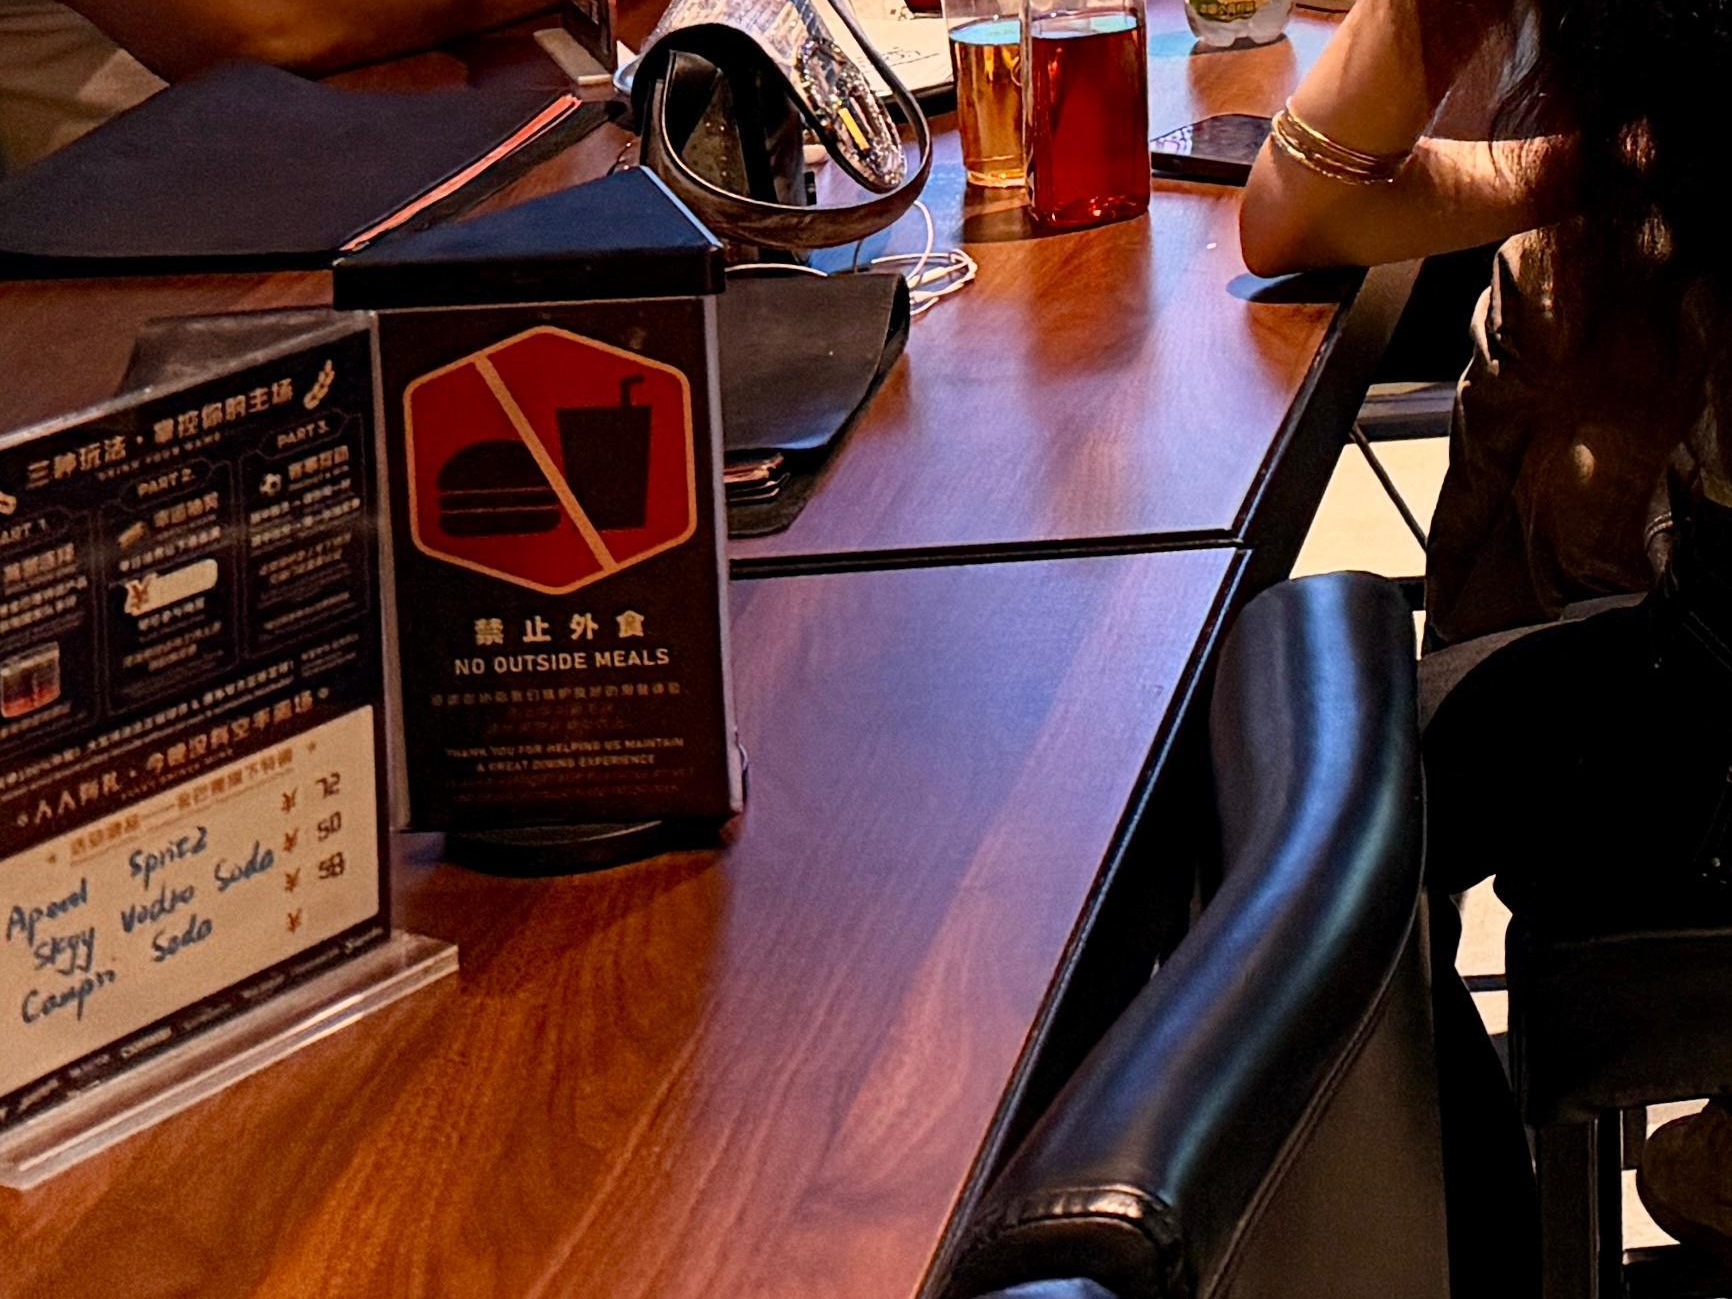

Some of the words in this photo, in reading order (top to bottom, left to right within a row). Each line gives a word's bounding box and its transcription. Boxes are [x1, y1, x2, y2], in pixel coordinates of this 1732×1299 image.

[473, 608, 646, 647] 禁止外食
[454, 657, 486, 677] NO
[494, 651, 588, 675] OUTSIDE
[595, 647, 671, 669] MEALS
